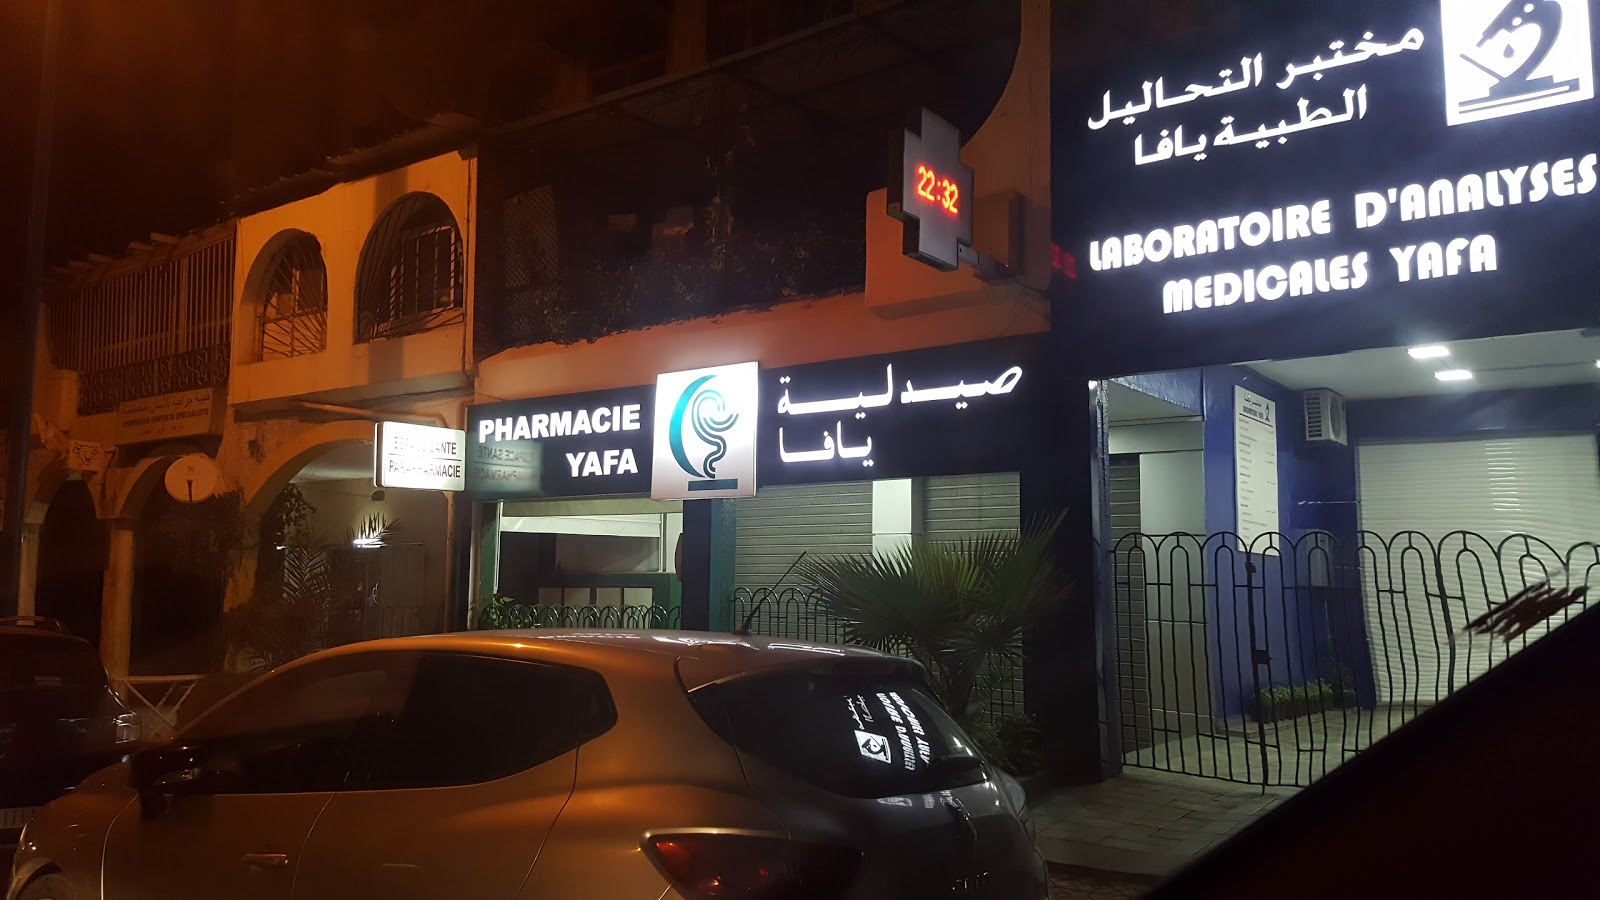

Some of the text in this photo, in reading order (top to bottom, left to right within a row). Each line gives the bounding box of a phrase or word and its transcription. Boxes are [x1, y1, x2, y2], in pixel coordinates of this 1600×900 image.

[1087, 27, 1425, 130] مختبر التحاليل
[1134, 83, 1367, 166] الطبية يافا
[916, 164, 960, 215] 22:32
[1089, 199, 1332, 271] LABORATOIRE
[1354, 153, 1597, 229] D'ANALYSES
[1162, 234, 1498, 314] MEDICALES YAFA
[777, 363, 1023, 420] صيدلية
[478, 403, 641, 444] PHARMACIE
[779, 420, 875, 468] يافا
[565, 448, 639, 478] YAFA
